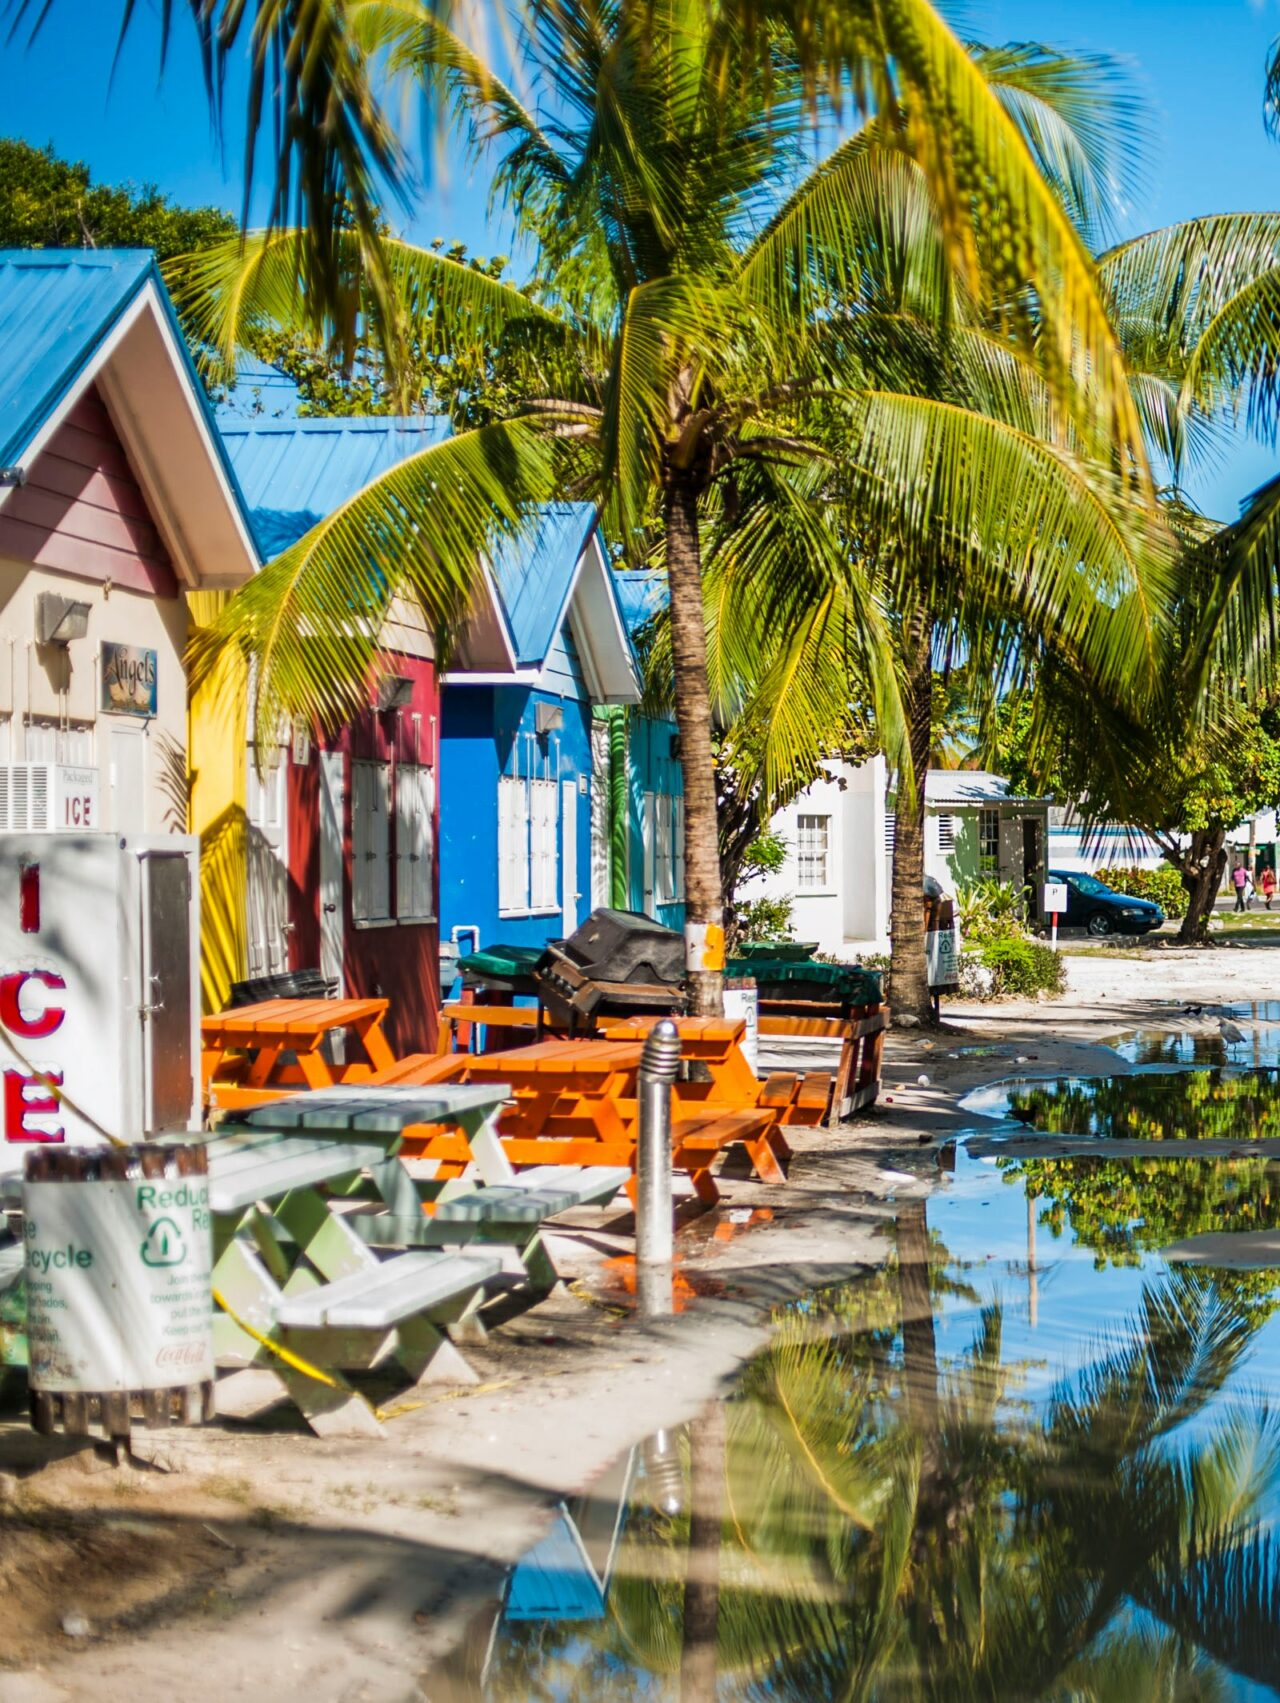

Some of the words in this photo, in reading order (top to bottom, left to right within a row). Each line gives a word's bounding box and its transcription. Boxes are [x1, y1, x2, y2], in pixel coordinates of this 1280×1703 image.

[103, 647, 154, 696] Angels
[63, 769, 93, 786] Packaged
[65, 797, 91, 826] ICE
[0, 857, 66, 1143] ICE
